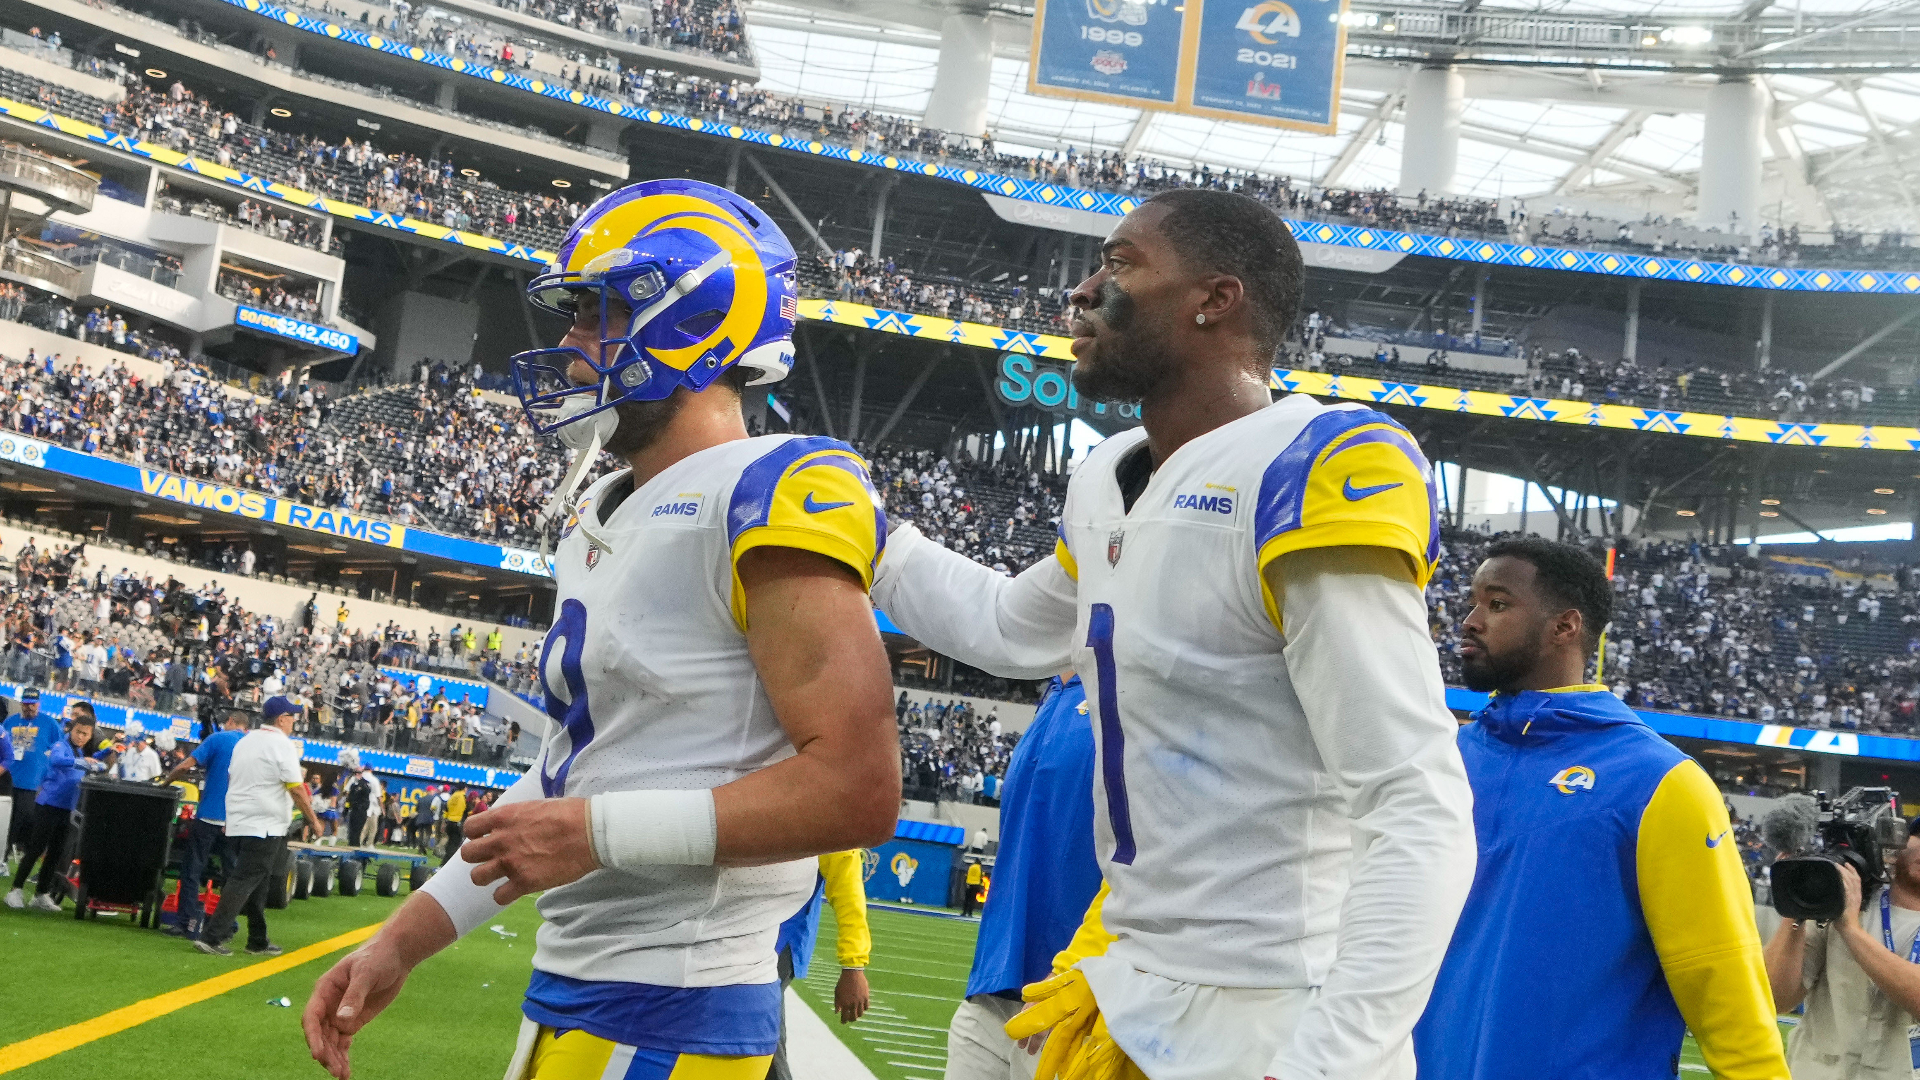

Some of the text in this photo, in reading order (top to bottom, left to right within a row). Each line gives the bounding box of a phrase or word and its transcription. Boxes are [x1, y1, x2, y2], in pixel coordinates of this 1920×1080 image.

[1081, 25, 1143, 47] 1999
[1237, 48, 1297, 70] 2021
[239, 309, 350, 350] 50/50 $242,450
[140, 469, 391, 546] VAMOS RAMS
[651, 502, 699, 518] RAMS
[1173, 494, 1233, 515] RAMS
[1085, 603, 1137, 866] 1
